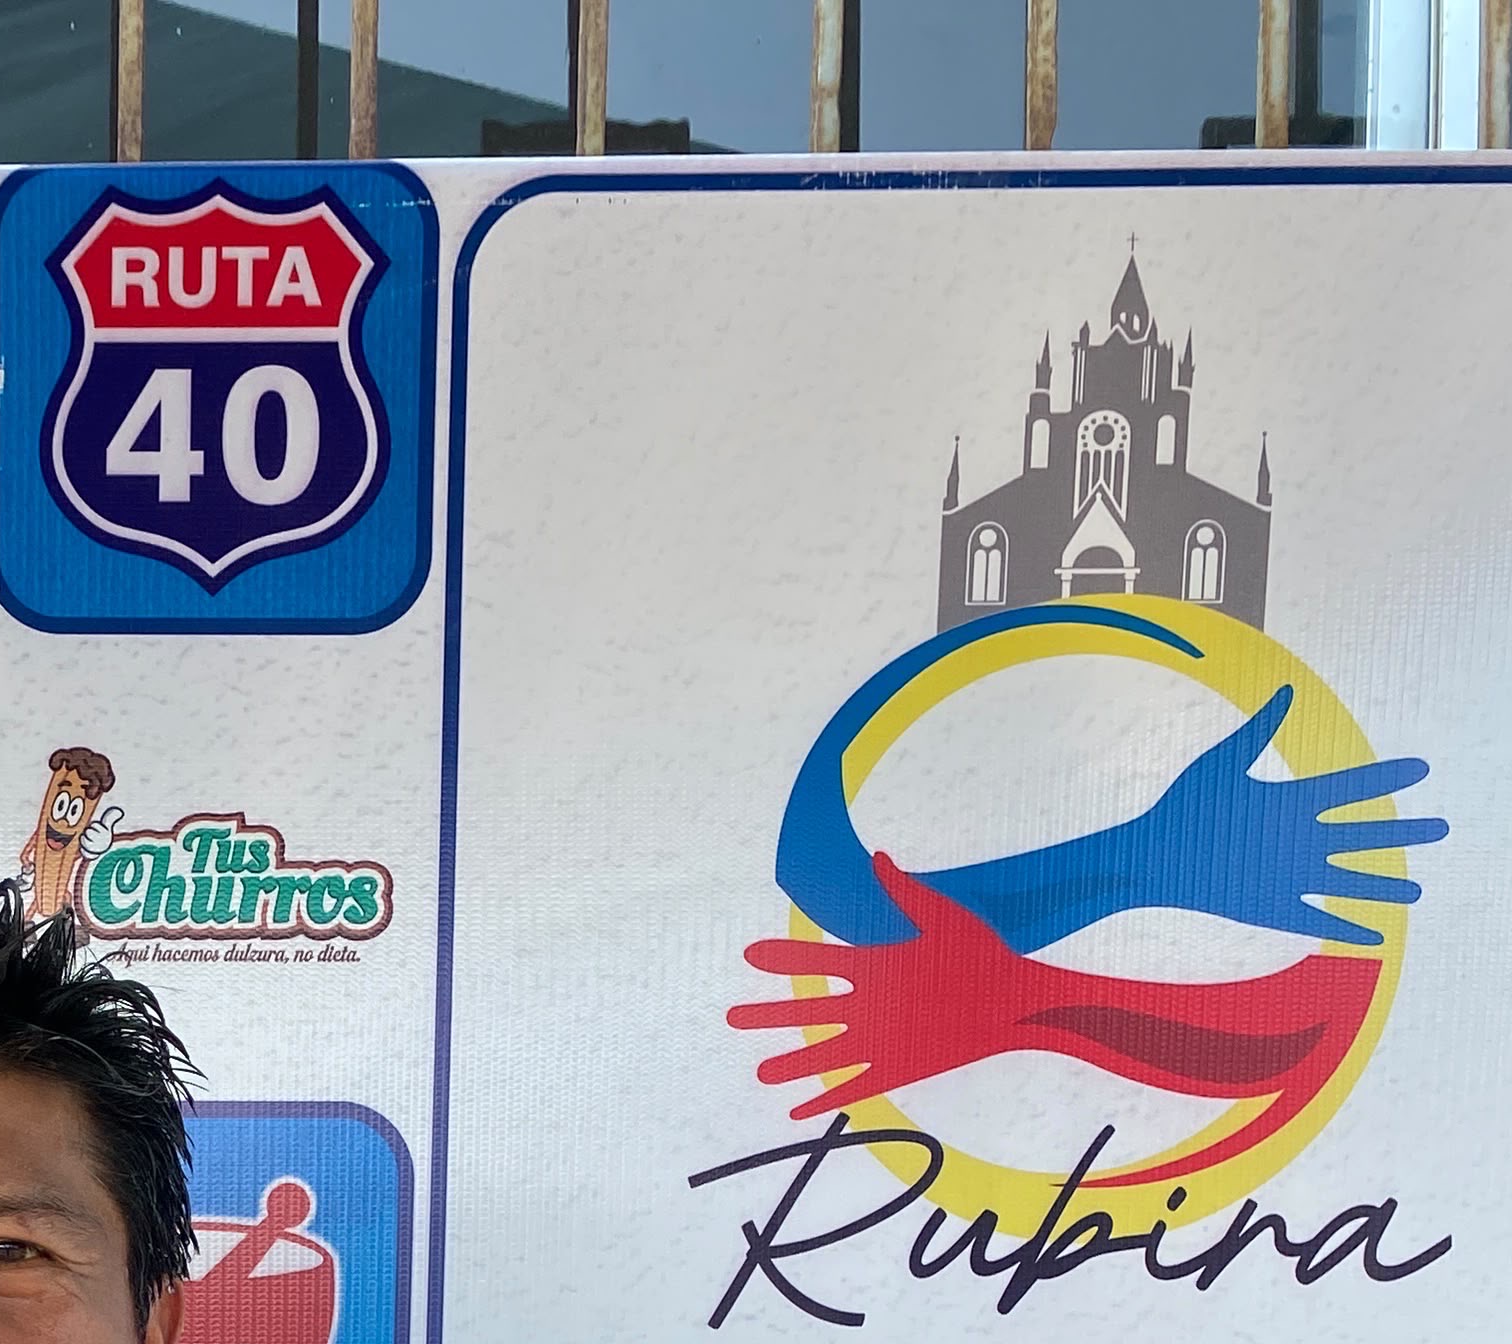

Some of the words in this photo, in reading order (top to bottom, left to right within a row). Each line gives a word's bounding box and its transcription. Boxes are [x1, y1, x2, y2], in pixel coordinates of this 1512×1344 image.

[108, 245, 322, 308] RUTA
[105, 364, 320, 506] 40
[183, 828, 271, 873] Tus
[89, 844, 379, 925] Churros
[152, 942, 220, 964] hacemos
[293, 948, 315, 964] no
